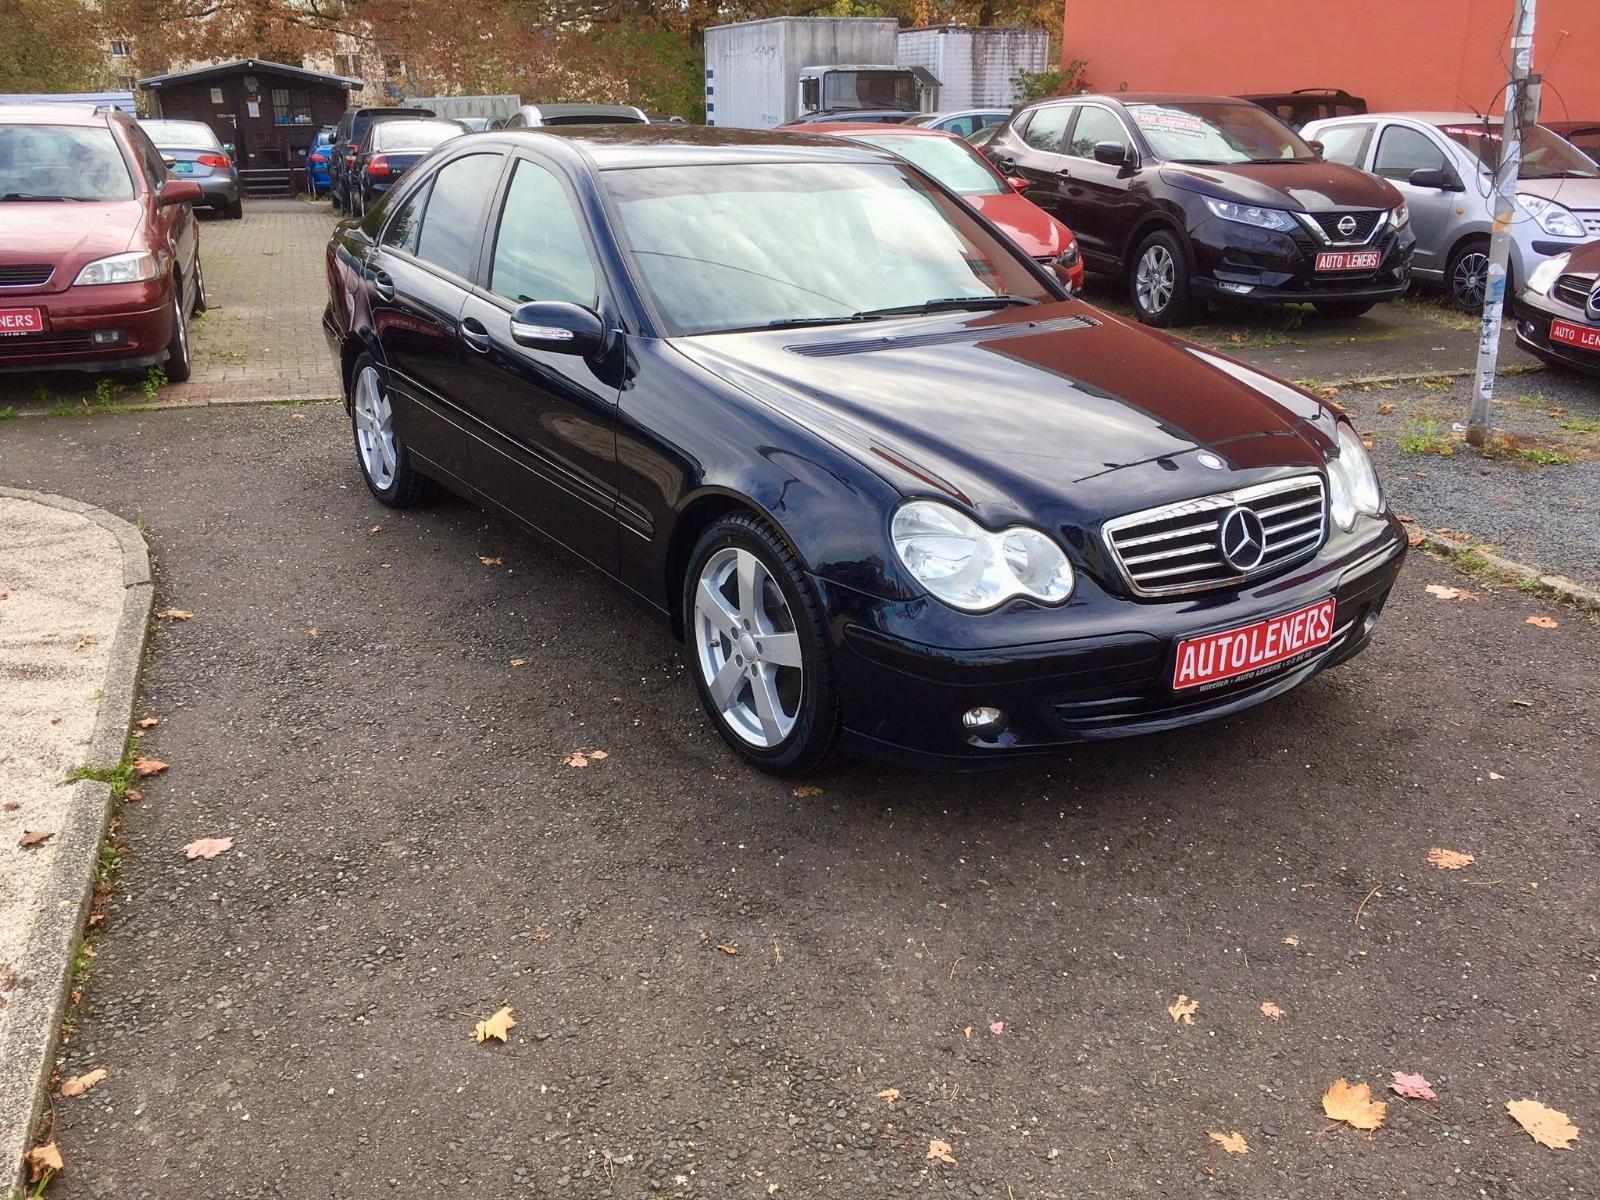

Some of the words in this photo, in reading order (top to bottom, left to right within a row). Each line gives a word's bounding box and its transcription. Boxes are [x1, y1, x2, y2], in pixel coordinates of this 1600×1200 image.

[1319, 255, 1343, 269] AUTO
[1346, 253, 1377, 268] LENERS
[1554, 326, 1575, 340] AUTO
